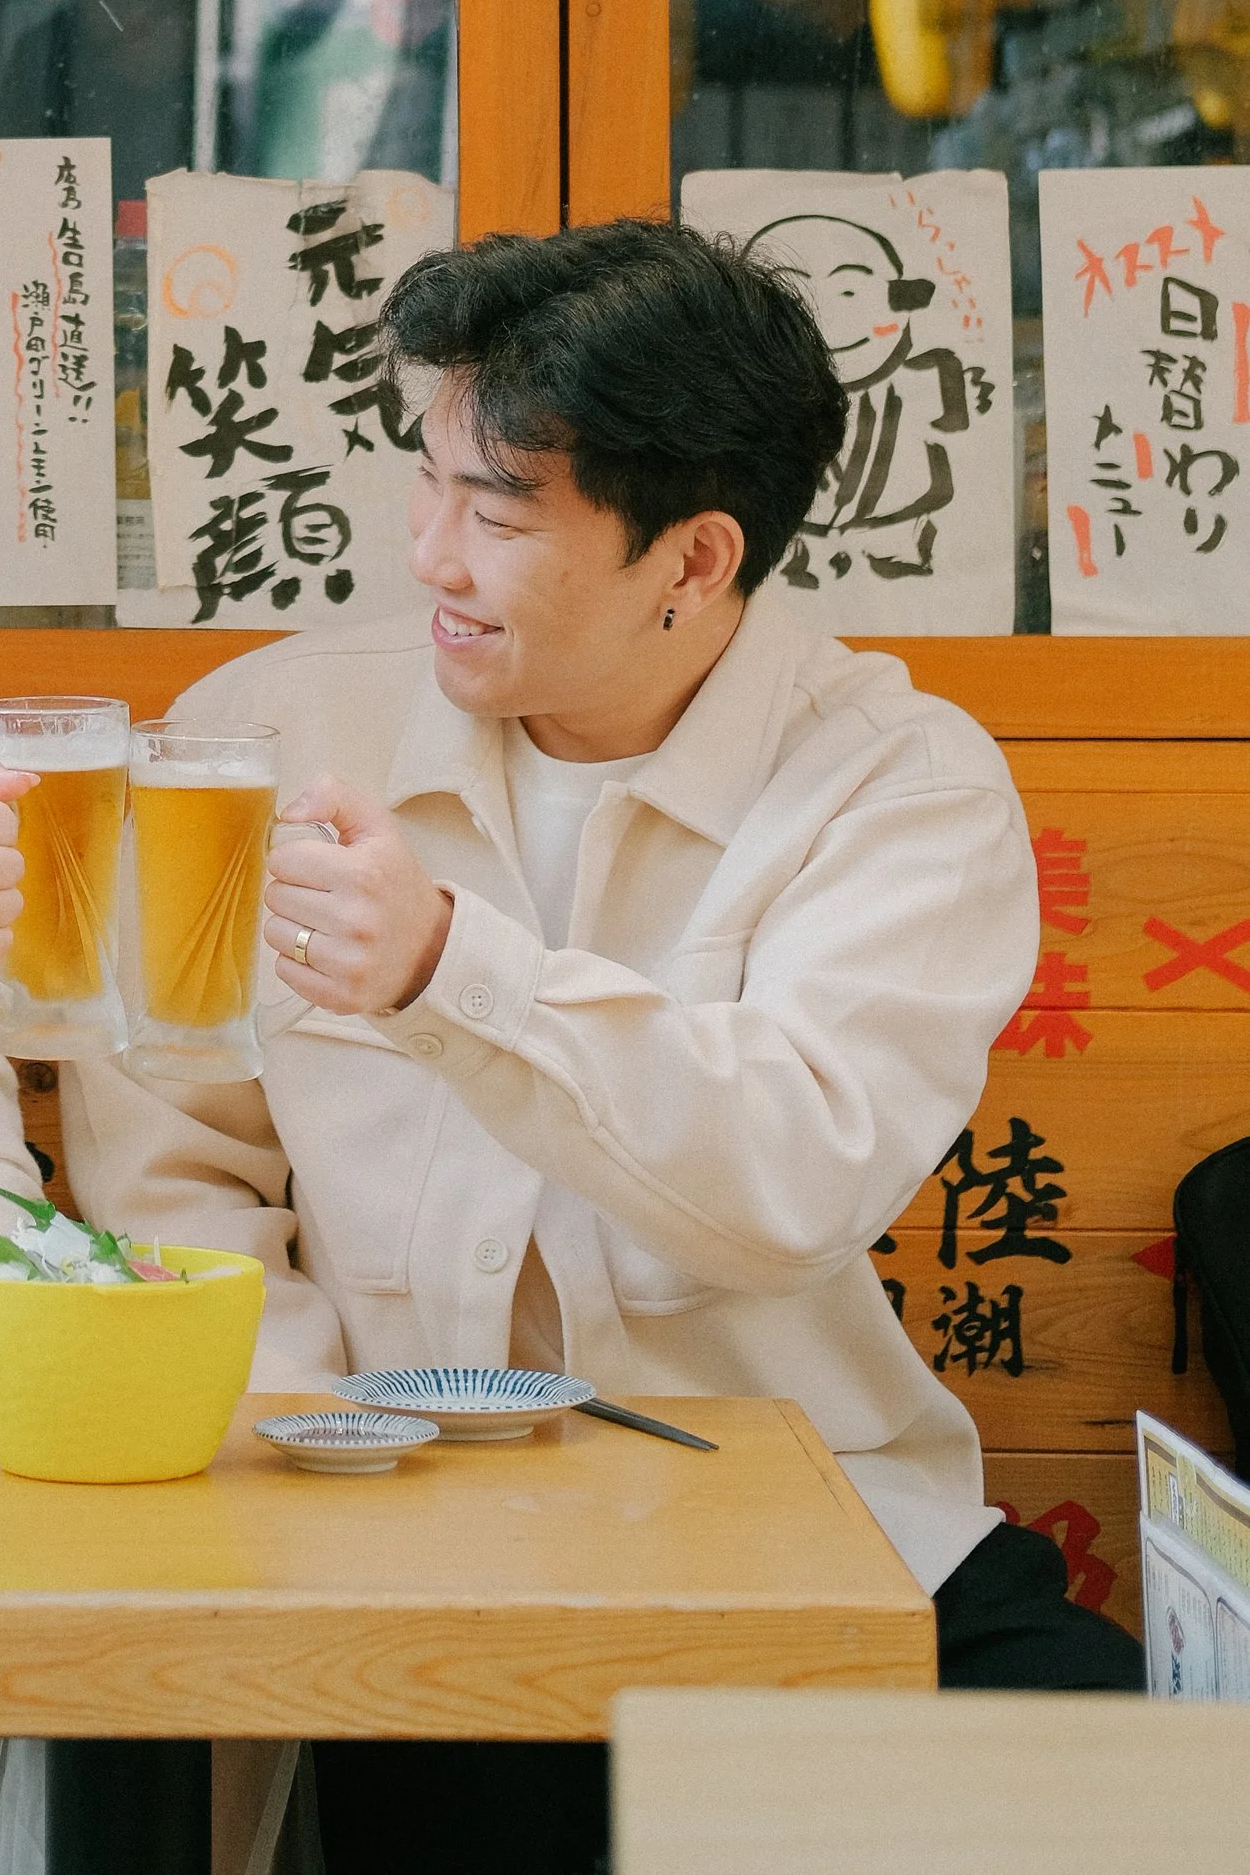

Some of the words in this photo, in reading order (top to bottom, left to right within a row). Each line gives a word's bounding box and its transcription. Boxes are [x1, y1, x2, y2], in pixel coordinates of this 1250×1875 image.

[164, 325, 354, 624] 笑顔
[1090, 404, 1143, 557] メニュー
[1141, 276, 1240, 555] 日替わり
